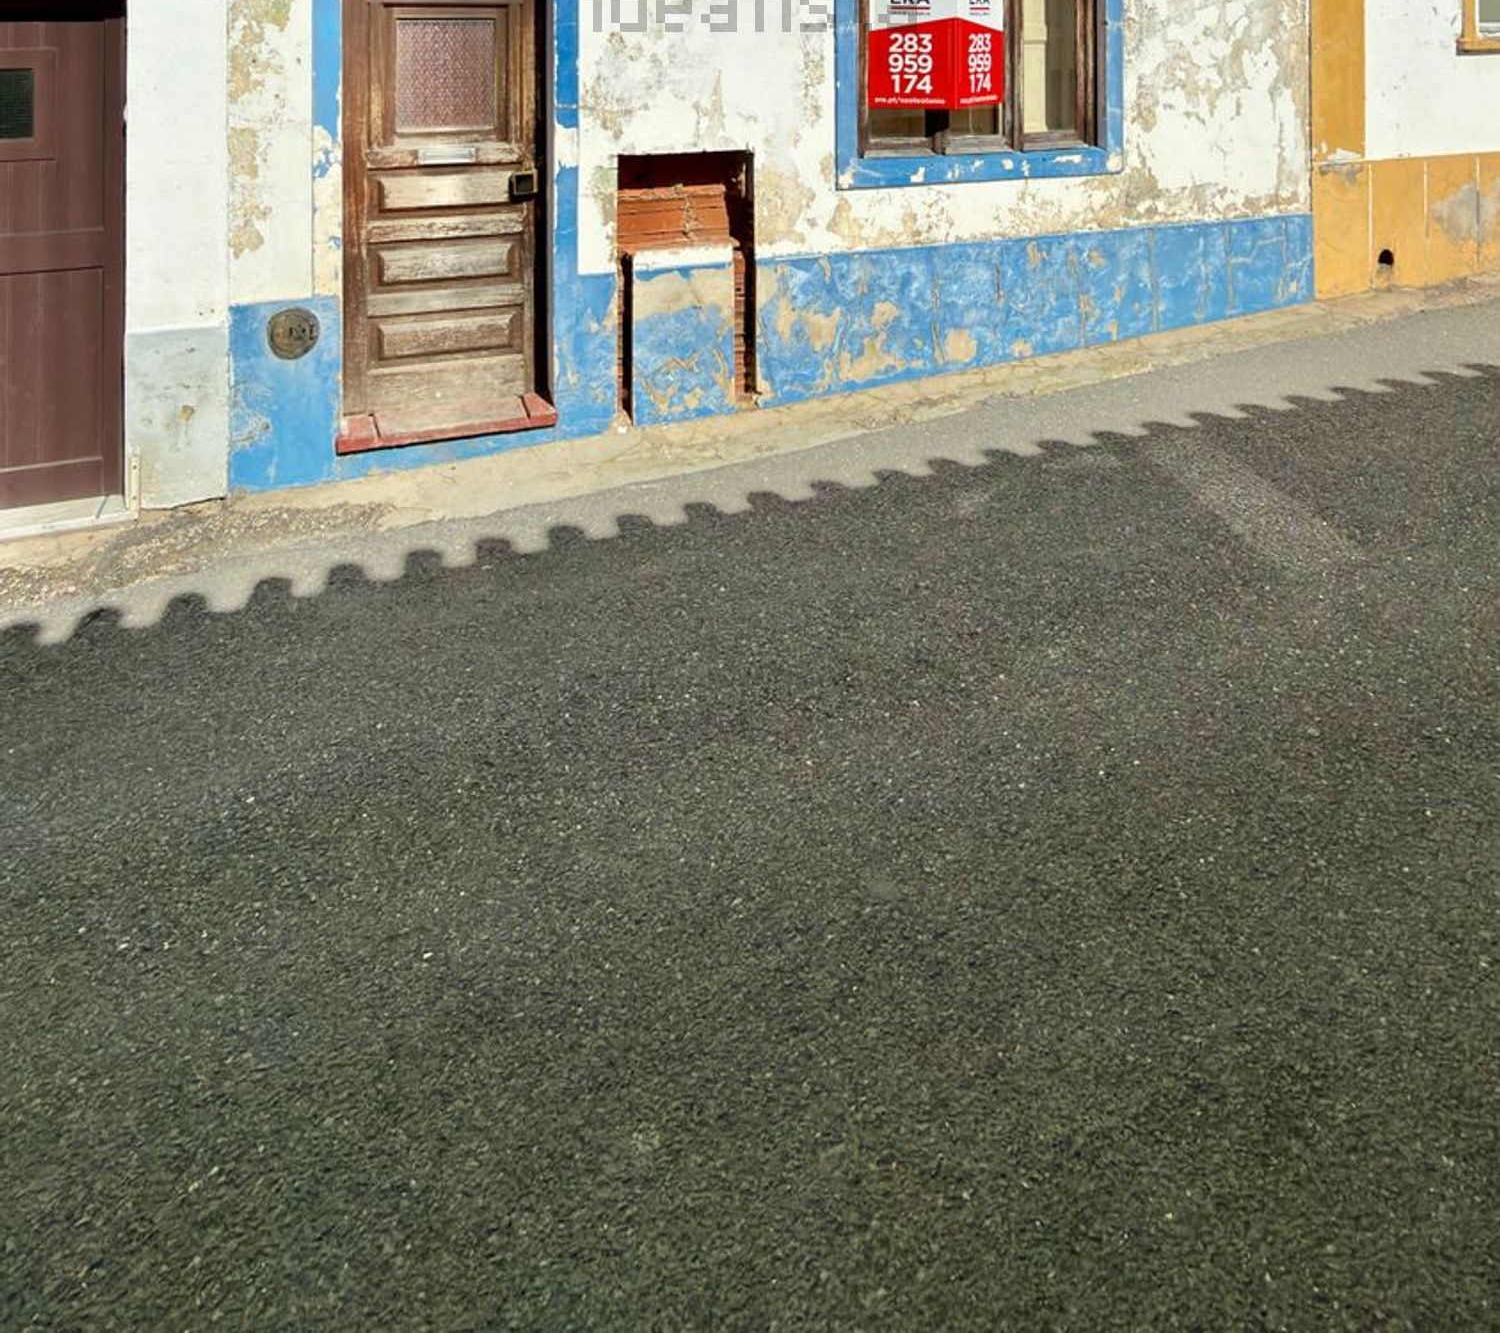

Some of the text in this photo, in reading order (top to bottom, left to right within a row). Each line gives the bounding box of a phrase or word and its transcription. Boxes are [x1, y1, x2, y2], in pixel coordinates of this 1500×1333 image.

[888, 33, 933, 53] 283
[968, 33, 992, 53] 283
[888, 53, 933, 74] 959
[968, 53, 992, 73] 959
[891, 74, 933, 94] 174
[969, 72, 992, 93] 174
